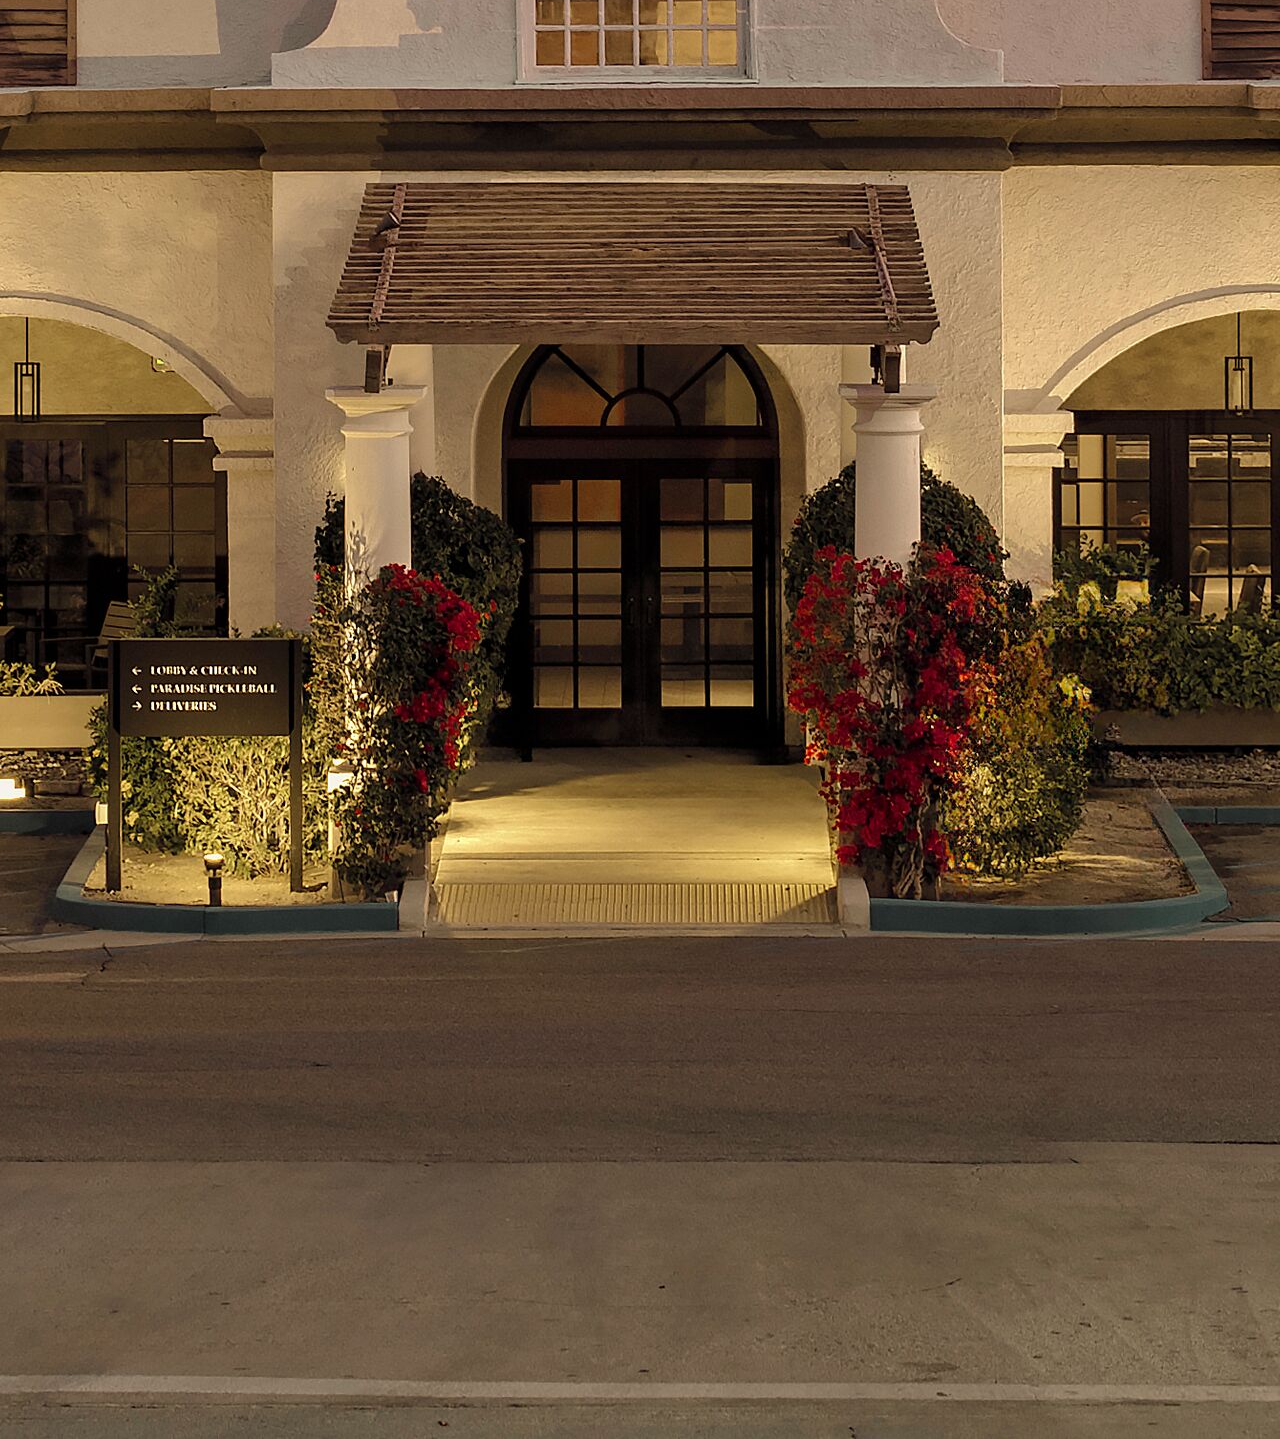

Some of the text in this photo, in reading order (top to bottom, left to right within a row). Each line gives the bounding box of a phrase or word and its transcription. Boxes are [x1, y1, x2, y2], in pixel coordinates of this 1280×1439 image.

[150, 665, 258, 675] LOBBY & CHECK-IN
[150, 684, 277, 694] PARADISE PICKLEBALL
[150, 701, 218, 711] DELIVERIES
